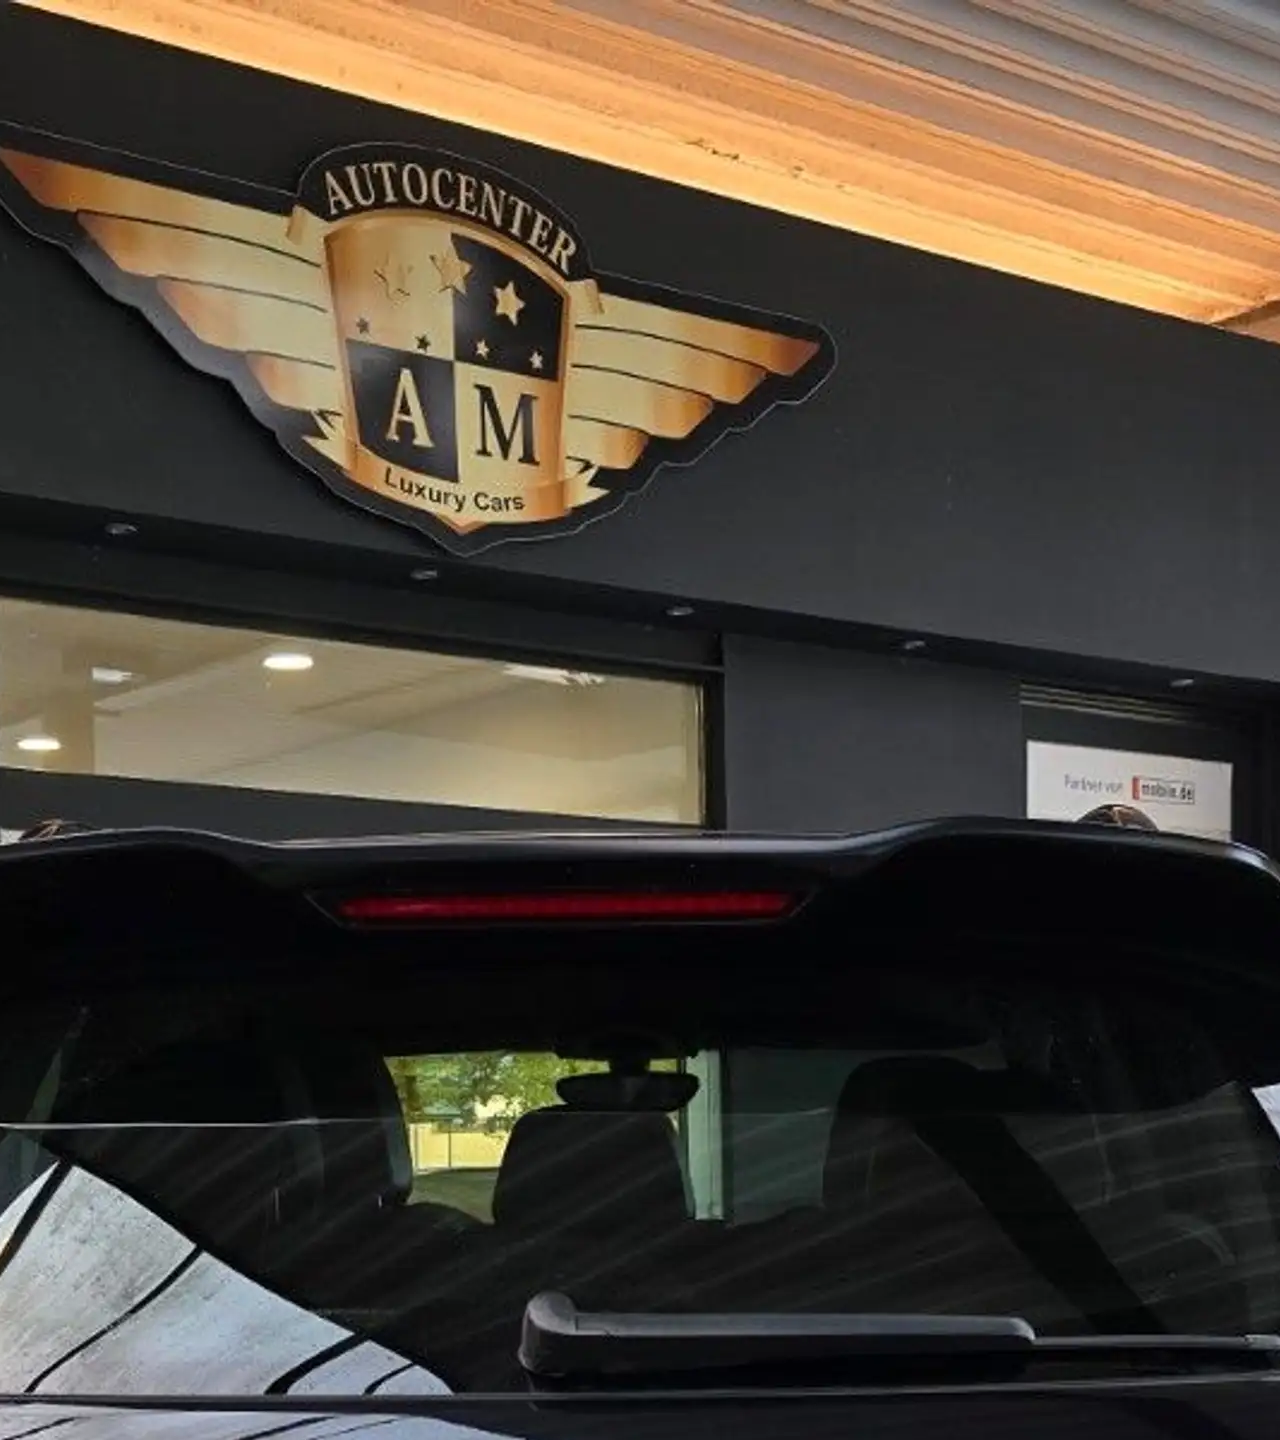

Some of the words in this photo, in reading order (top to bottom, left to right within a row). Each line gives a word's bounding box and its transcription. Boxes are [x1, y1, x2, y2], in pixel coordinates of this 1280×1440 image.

[325, 162, 577, 275] AUTOCENTER
[386, 368, 435, 448] A
[474, 384, 540, 466] M
[384, 466, 466, 513] Luxury
[473, 491, 525, 512] Cars
